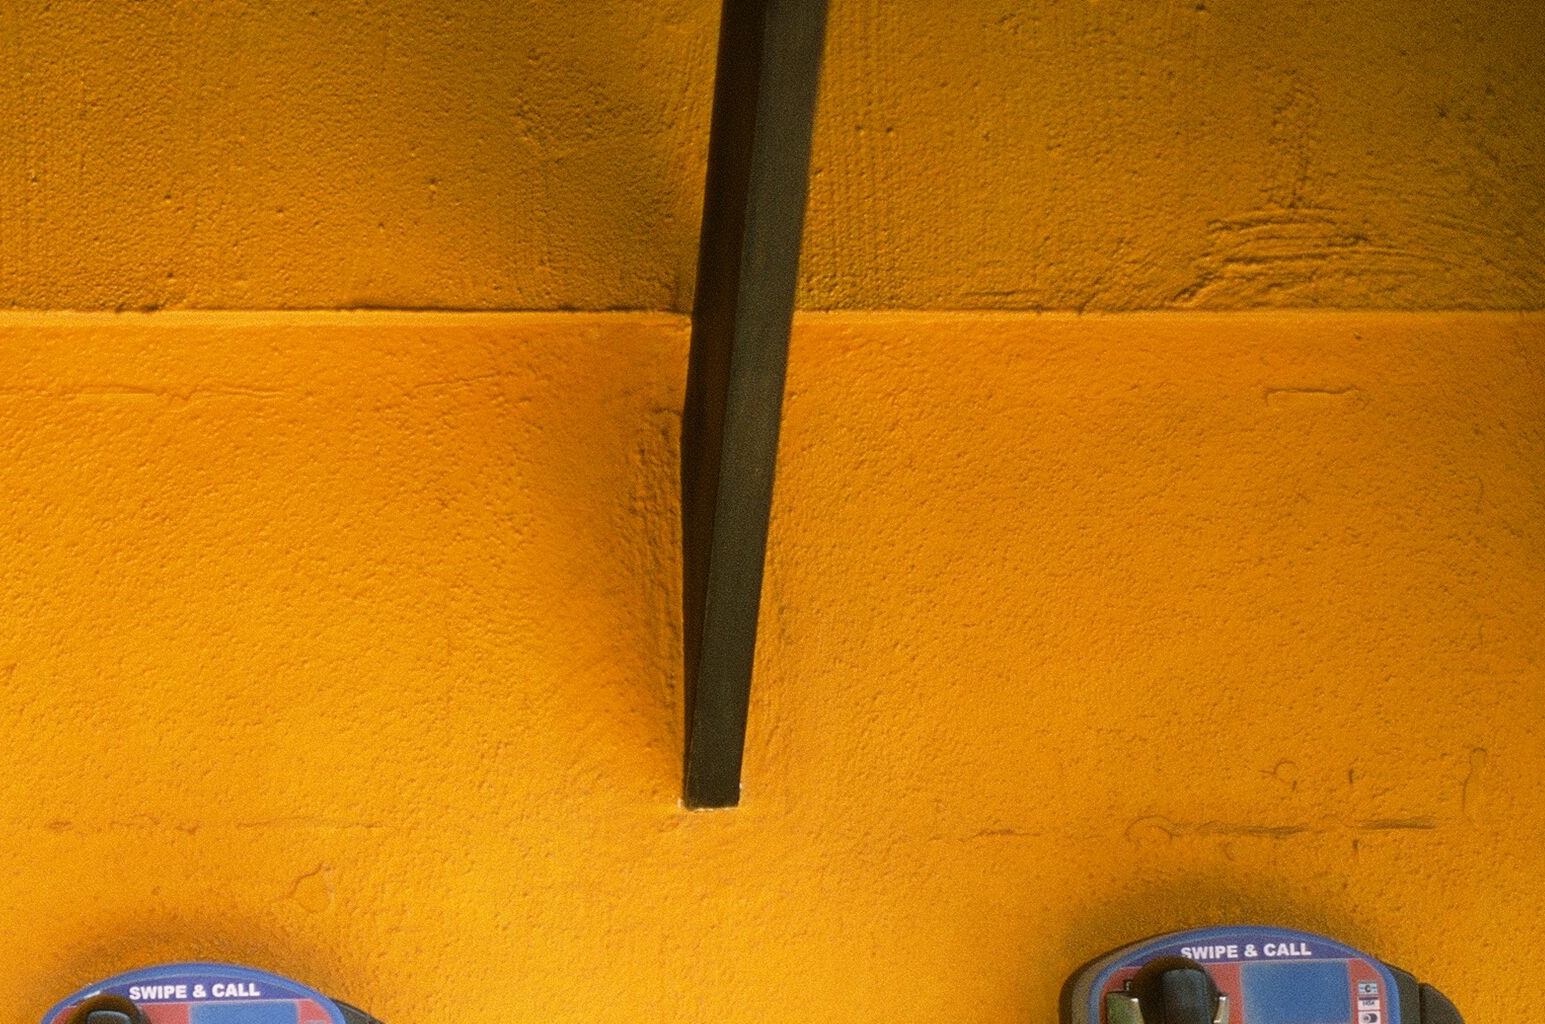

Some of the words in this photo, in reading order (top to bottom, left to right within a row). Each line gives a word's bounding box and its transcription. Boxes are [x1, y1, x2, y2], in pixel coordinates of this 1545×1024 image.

[1180, 945, 1238, 959] SWIPE
[1244, 944, 1258, 957] &
[1263, 943, 1312, 957] CALL
[129, 985, 187, 1000] SWIPE
[192, 984, 207, 998] &
[212, 983, 261, 997] CALL
